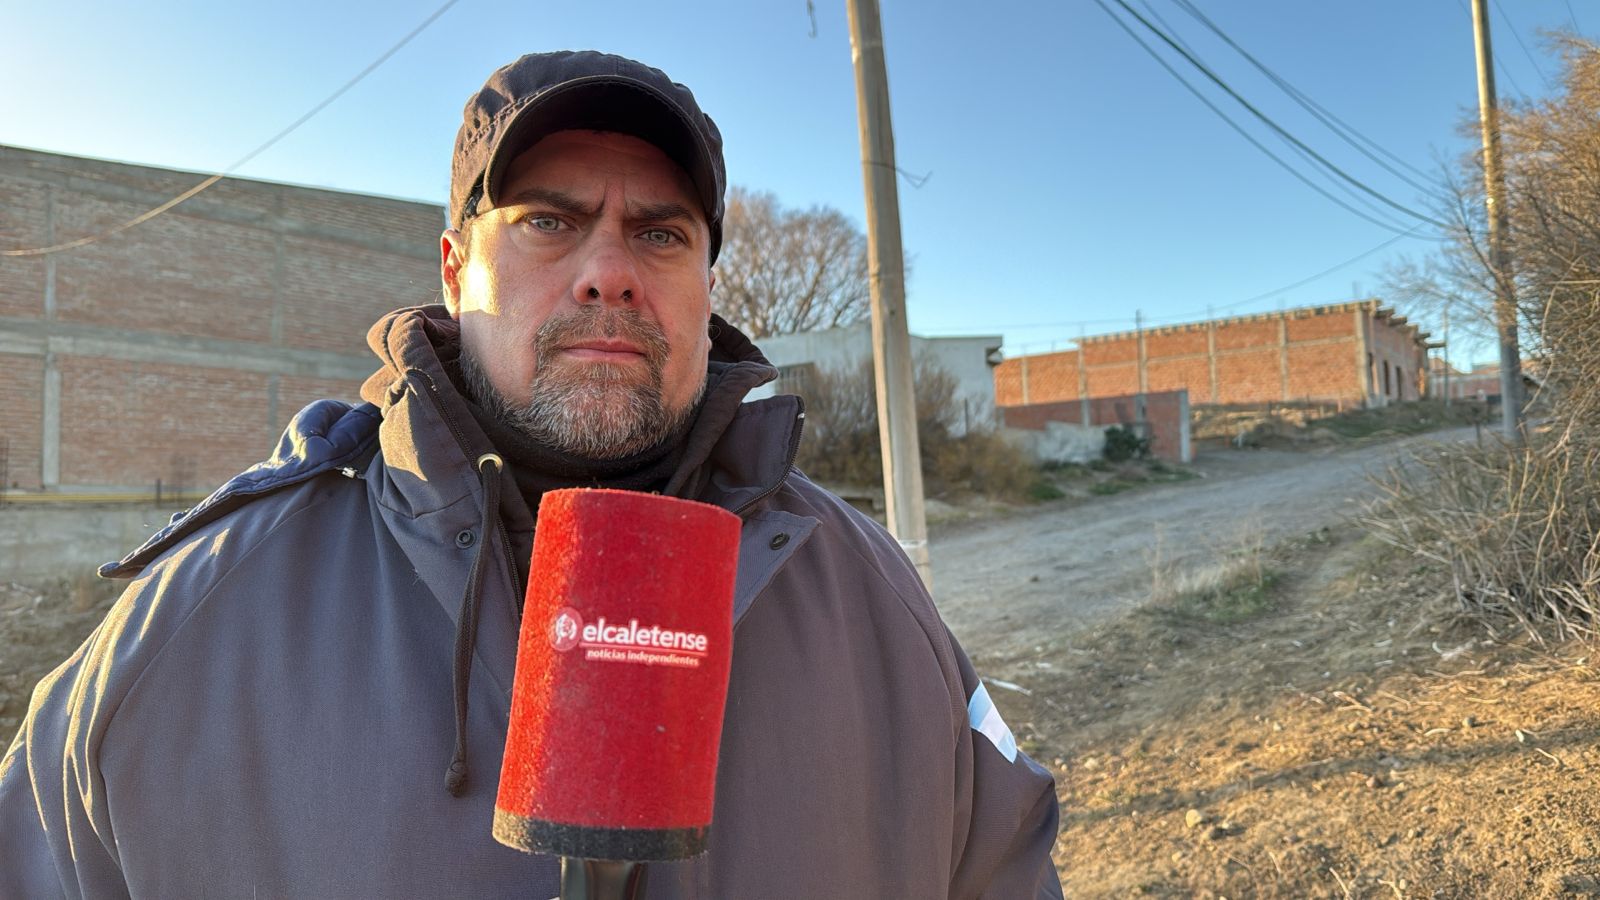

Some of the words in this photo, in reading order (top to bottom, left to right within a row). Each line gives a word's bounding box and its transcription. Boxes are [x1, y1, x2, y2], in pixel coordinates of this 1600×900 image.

[582, 617, 708, 651] elcaletense
[587, 649, 626, 660] noticias
[627, 650, 700, 666] independientes
